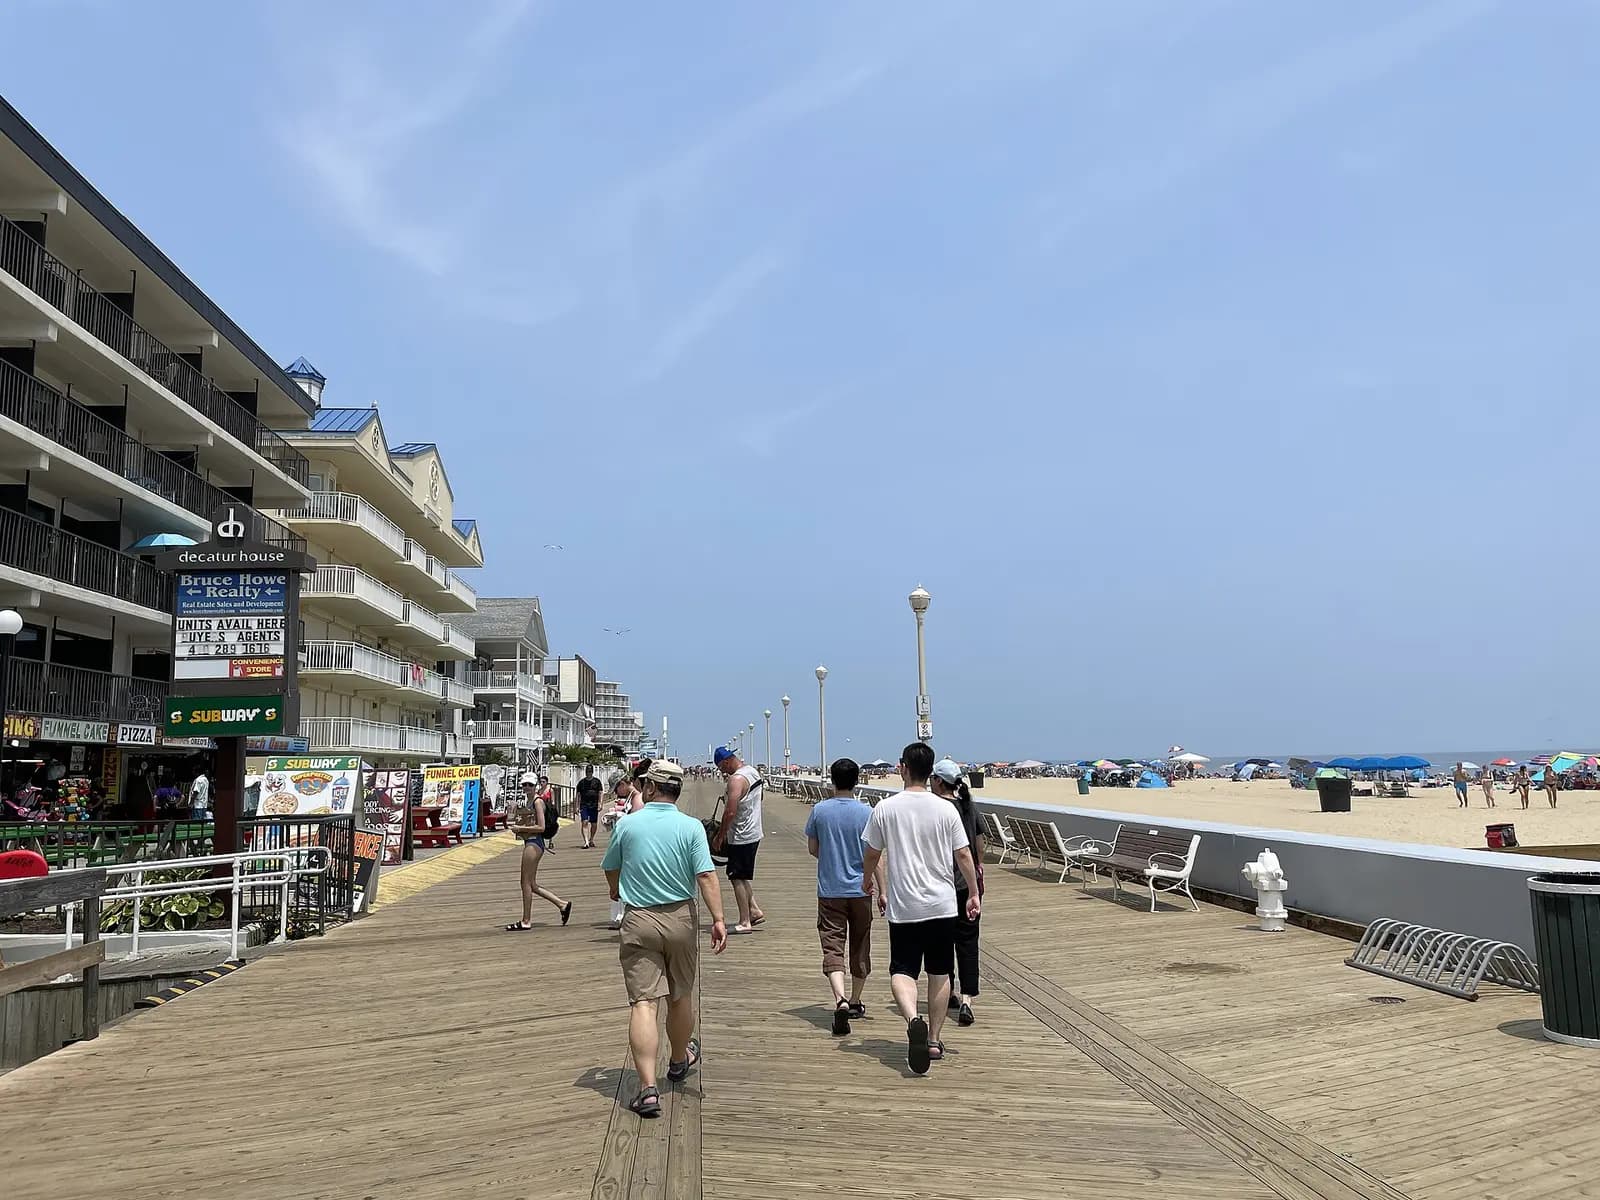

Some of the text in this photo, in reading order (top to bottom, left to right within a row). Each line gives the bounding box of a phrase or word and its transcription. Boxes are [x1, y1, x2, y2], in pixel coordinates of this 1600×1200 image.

[178, 550, 285, 563] decatur house
[180, 573, 286, 586] Bruce Howe
[206, 586, 261, 599] Realty
[246, 600, 284, 609] Development
[178, 618, 285, 630] UNITS AVAIL HERE
[237, 630, 281, 642] AGENTS
[215, 644, 236, 655] 289
[232, 658, 284, 666] CONVENIENCE
[189, 708, 261, 724] SUBWAY
[43, 719, 81, 739] FUNNEL
[83, 722, 108, 740] CAKE
[120, 726, 153, 743] PIZZA
[284, 758, 341, 769] SUBWAY
[426, 767, 480, 779] FUNNEL CAKE
[364, 806, 391, 814] ERCING
[465, 780, 476, 833] PIZZA
